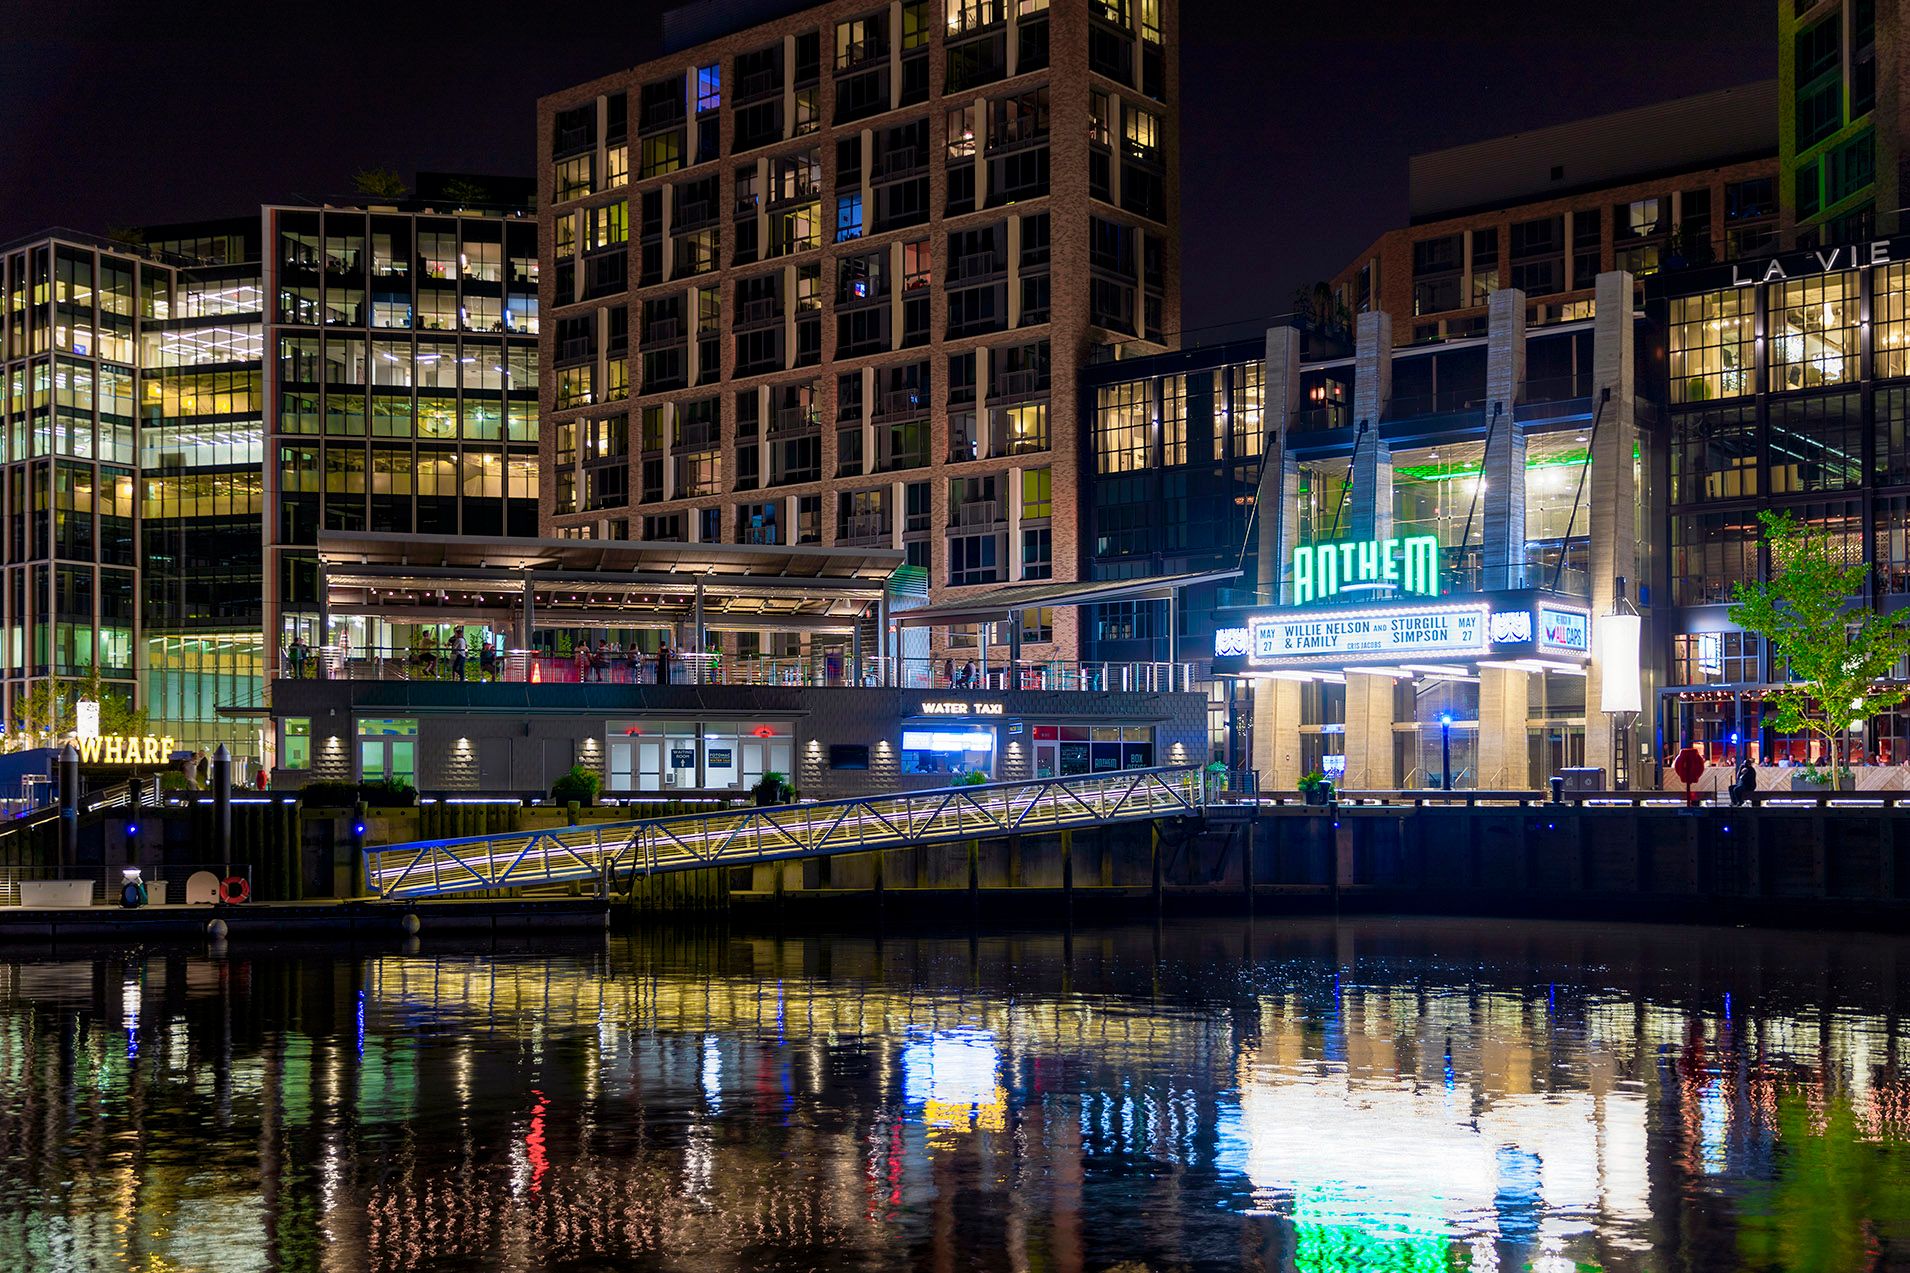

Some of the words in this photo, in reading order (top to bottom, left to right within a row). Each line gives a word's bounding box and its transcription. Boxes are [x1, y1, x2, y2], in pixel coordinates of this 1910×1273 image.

[1733, 259, 1787, 286] LA
[1815, 240, 1891, 271] VIE
[1293, 535, 1438, 606] ANTHEM
[1391, 616, 1448, 631] STURGILL
[1458, 617, 1476, 628] MAY
[1260, 628, 1275, 639] MAY
[1284, 623, 1322, 637] WILLIE
[1326, 621, 1370, 634] NELSON
[1373, 624, 1387, 632] AND
[1392, 629, 1448, 643] SIMPSON
[1462, 630, 1472, 641] 27
[1263, 641, 1272, 652] 27
[1284, 637, 1293, 649] &
[1297, 635, 1338, 648] FAMILY
[1347, 642, 1360, 650] CRIS
[1360, 641, 1382, 649] JACOBS
[921, 703, 968, 714] WATER
[973, 703, 1003, 714] TAXI
[77, 735, 174, 764] WHARF
[1130, 754, 1143, 763] BOX
